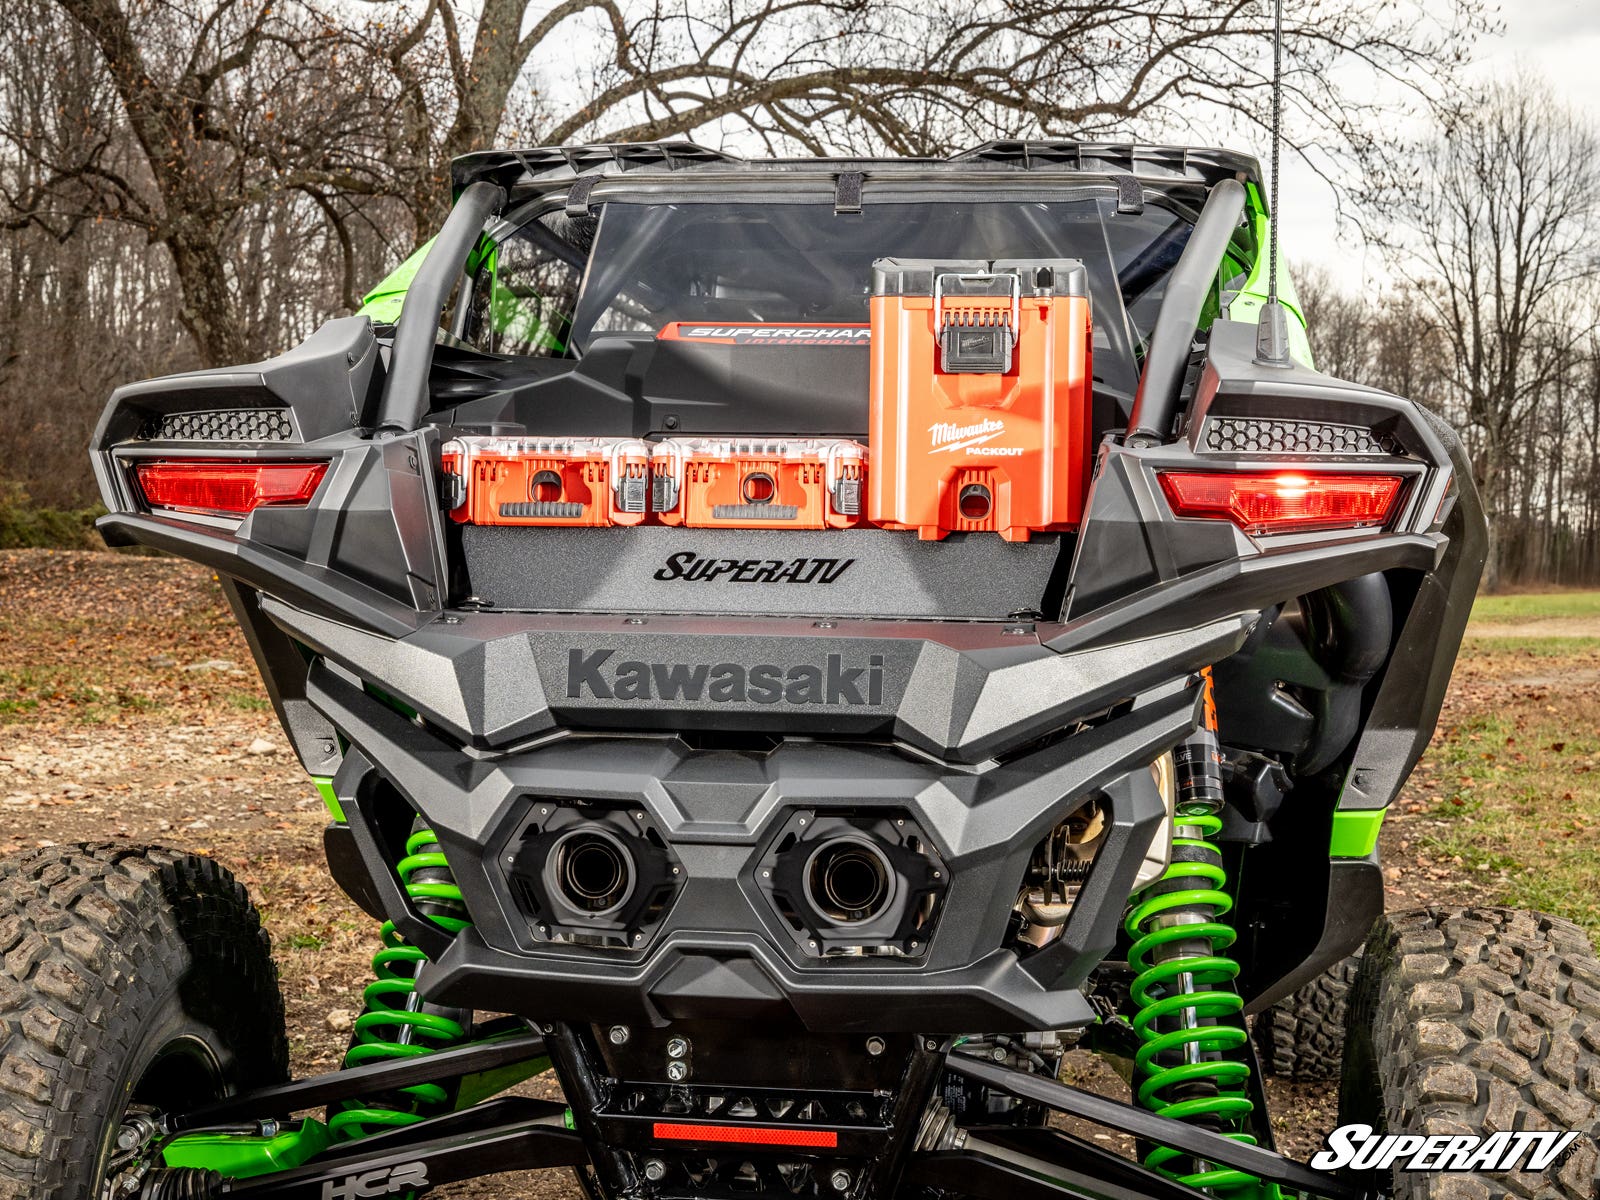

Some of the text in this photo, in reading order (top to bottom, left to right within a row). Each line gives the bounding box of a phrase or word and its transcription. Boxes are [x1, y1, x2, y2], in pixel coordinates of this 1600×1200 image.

[927, 418, 1004, 446] Milwaukee
[966, 447, 1025, 456] PACKOUT
[566, 648, 884, 705] Kawasaki
[321, 1161, 430, 1200] HCR
